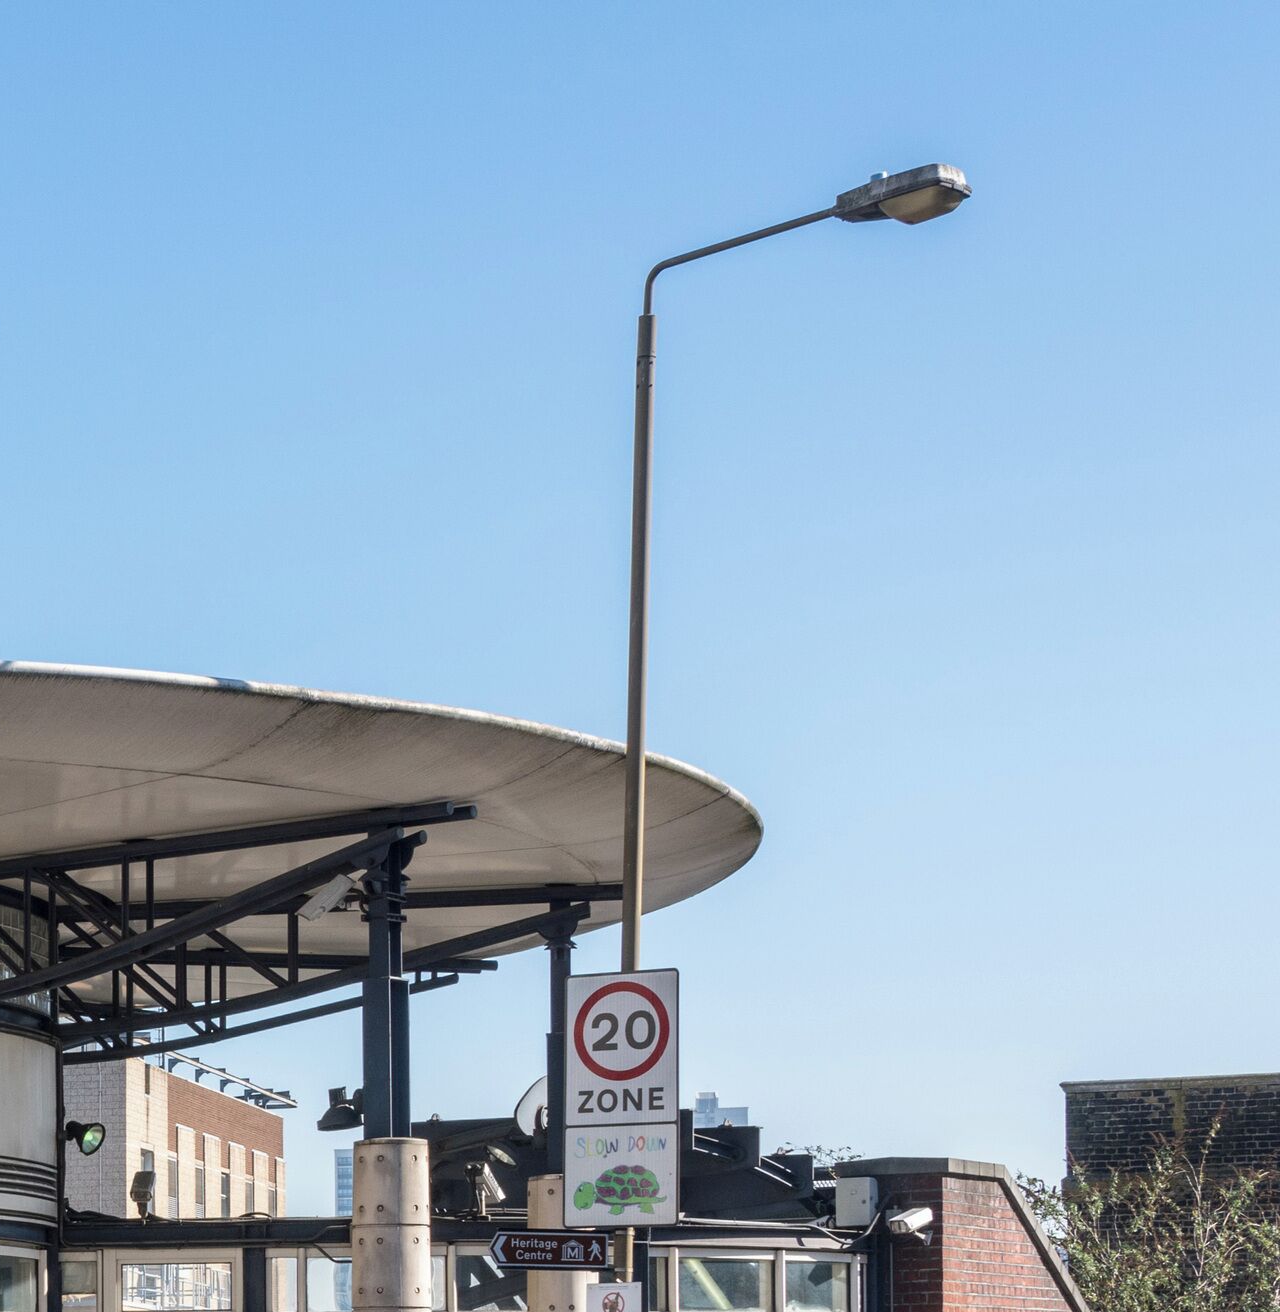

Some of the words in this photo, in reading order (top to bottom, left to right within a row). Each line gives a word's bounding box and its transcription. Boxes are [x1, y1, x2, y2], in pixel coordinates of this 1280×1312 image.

[591, 1010, 656, 1052] 20
[577, 1086, 665, 1114] ZONE
[575, 1136, 619, 1158] SLOW
[628, 1135, 667, 1152] DOWN
[511, 1238, 558, 1249] Heritage
[515, 1250, 553, 1260] Centre
